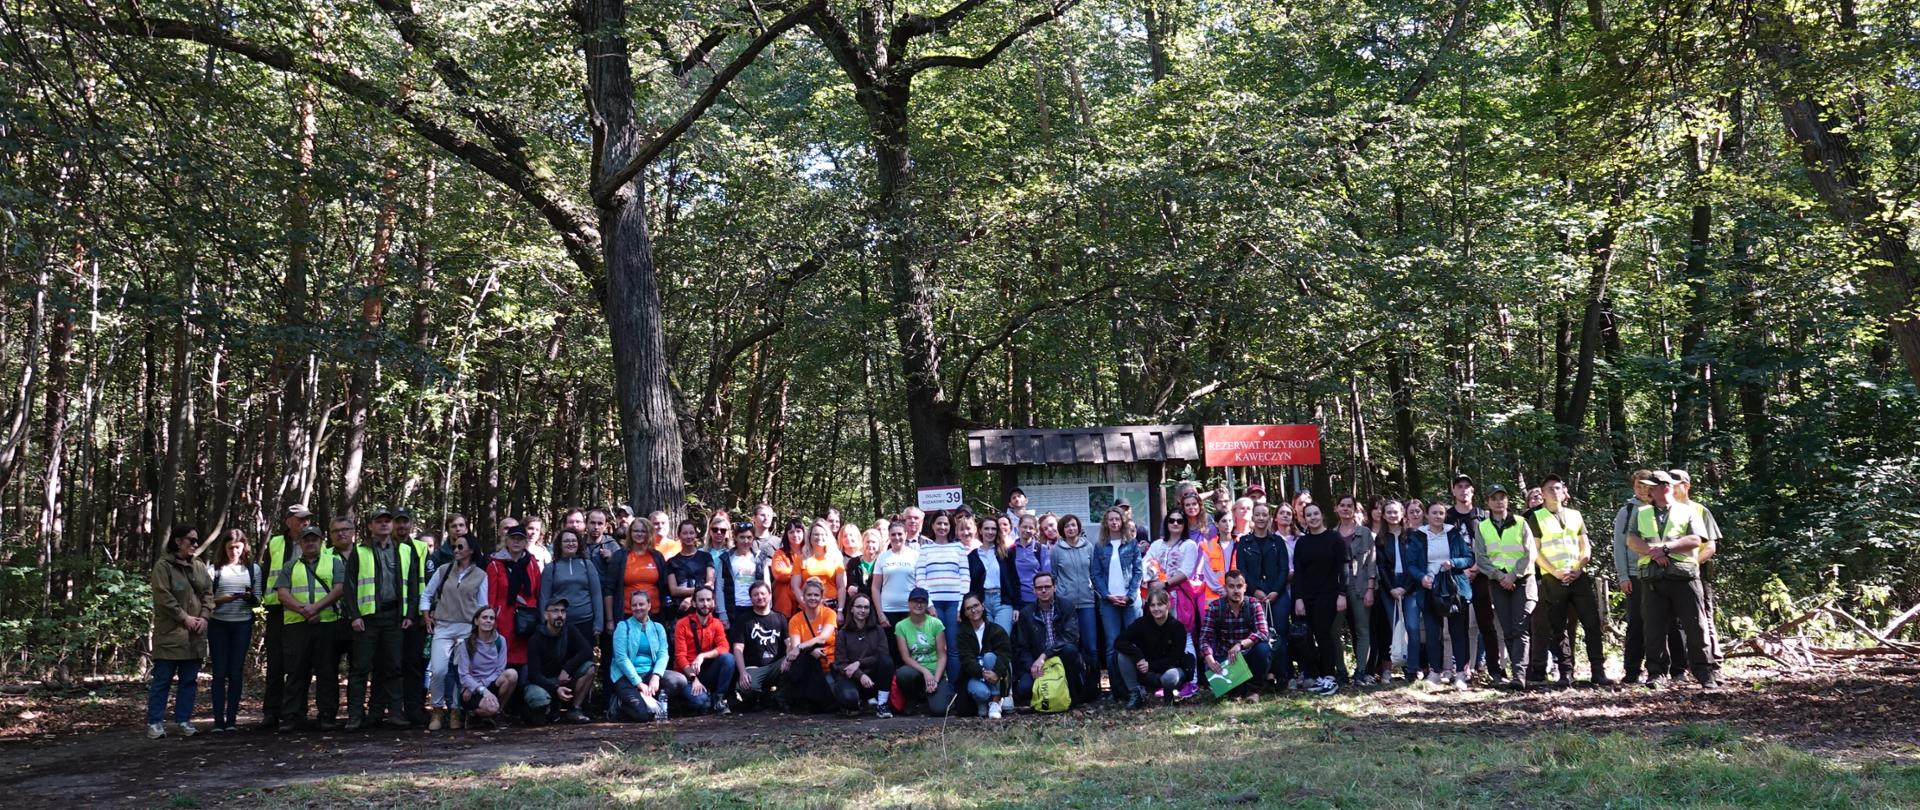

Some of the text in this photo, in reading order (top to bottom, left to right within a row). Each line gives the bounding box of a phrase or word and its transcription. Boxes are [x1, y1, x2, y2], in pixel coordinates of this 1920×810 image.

[1208, 439, 1316, 450] REZERWAT PRZYRODY
[1234, 452, 1292, 462] KAWĘCZYN
[946, 492, 961, 503] 39
